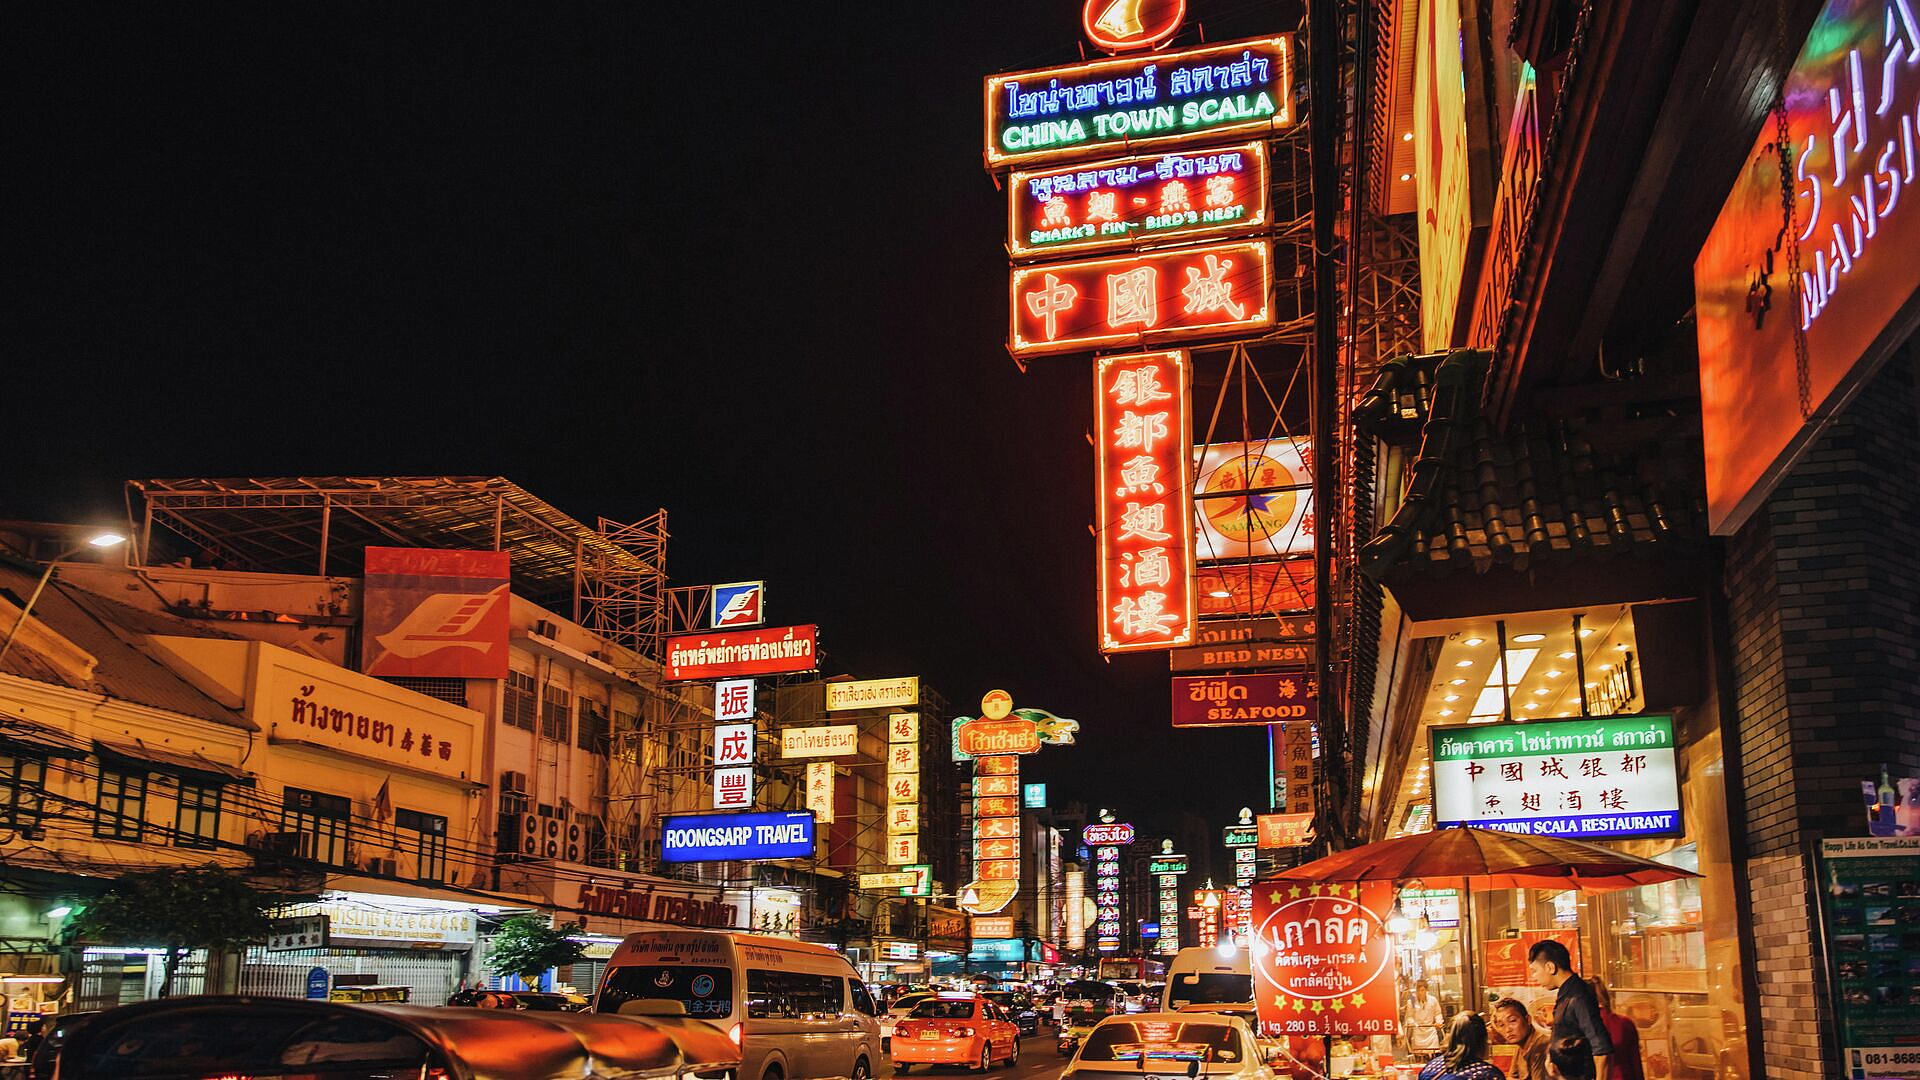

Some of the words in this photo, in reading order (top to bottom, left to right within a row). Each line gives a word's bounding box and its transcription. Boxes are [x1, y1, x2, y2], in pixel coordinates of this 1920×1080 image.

[1002, 118, 1086, 149] CHINA
[1093, 105, 1175, 137] TOWN
[1182, 91, 1275, 125] SCALA
[1030, 224, 1095, 244] SHARK'S
[1145, 211, 1198, 230] BIRD'S
[1202, 205, 1245, 222] NEST
[1802, 95, 1920, 331] MANSI
[1026, 254, 1245, 341] 中國城
[1109, 365, 1179, 635] 銀都魚翅酒樓
[1203, 650, 1251, 665] BIRD
[1257, 647, 1308, 661] NEST
[292, 685, 394, 746] ห้างขายยา
[1208, 705, 1306, 720] SEAFOOD
[719, 685, 749, 805] 振成豐
[1440, 736, 1514, 757] ภัตตาคาร
[1516, 727, 1605, 752] ไชน่าทาวน์
[1613, 723, 1666, 746] สกาล่า
[1464, 753, 1647, 783] 中國城銀都
[1481, 787, 1630, 815] 魚翅酒樓
[665, 826, 753, 849] ROONGSARP
[756, 823, 808, 845] TRAVEL
[1534, 819, 1577, 835] SCALA
[1581, 814, 1673, 832] RESTAURANT
[1824, 841, 1843, 852] Happy
[1269, 1020, 1284, 1034] kg.
[1286, 1020, 1305, 1032] 280
[1308, 1020, 1320, 1032] B.
[1335, 1019, 1352, 1034] kg.
[1357, 1019, 1380, 1031] 140
[1384, 1020, 1397, 1032] B.
